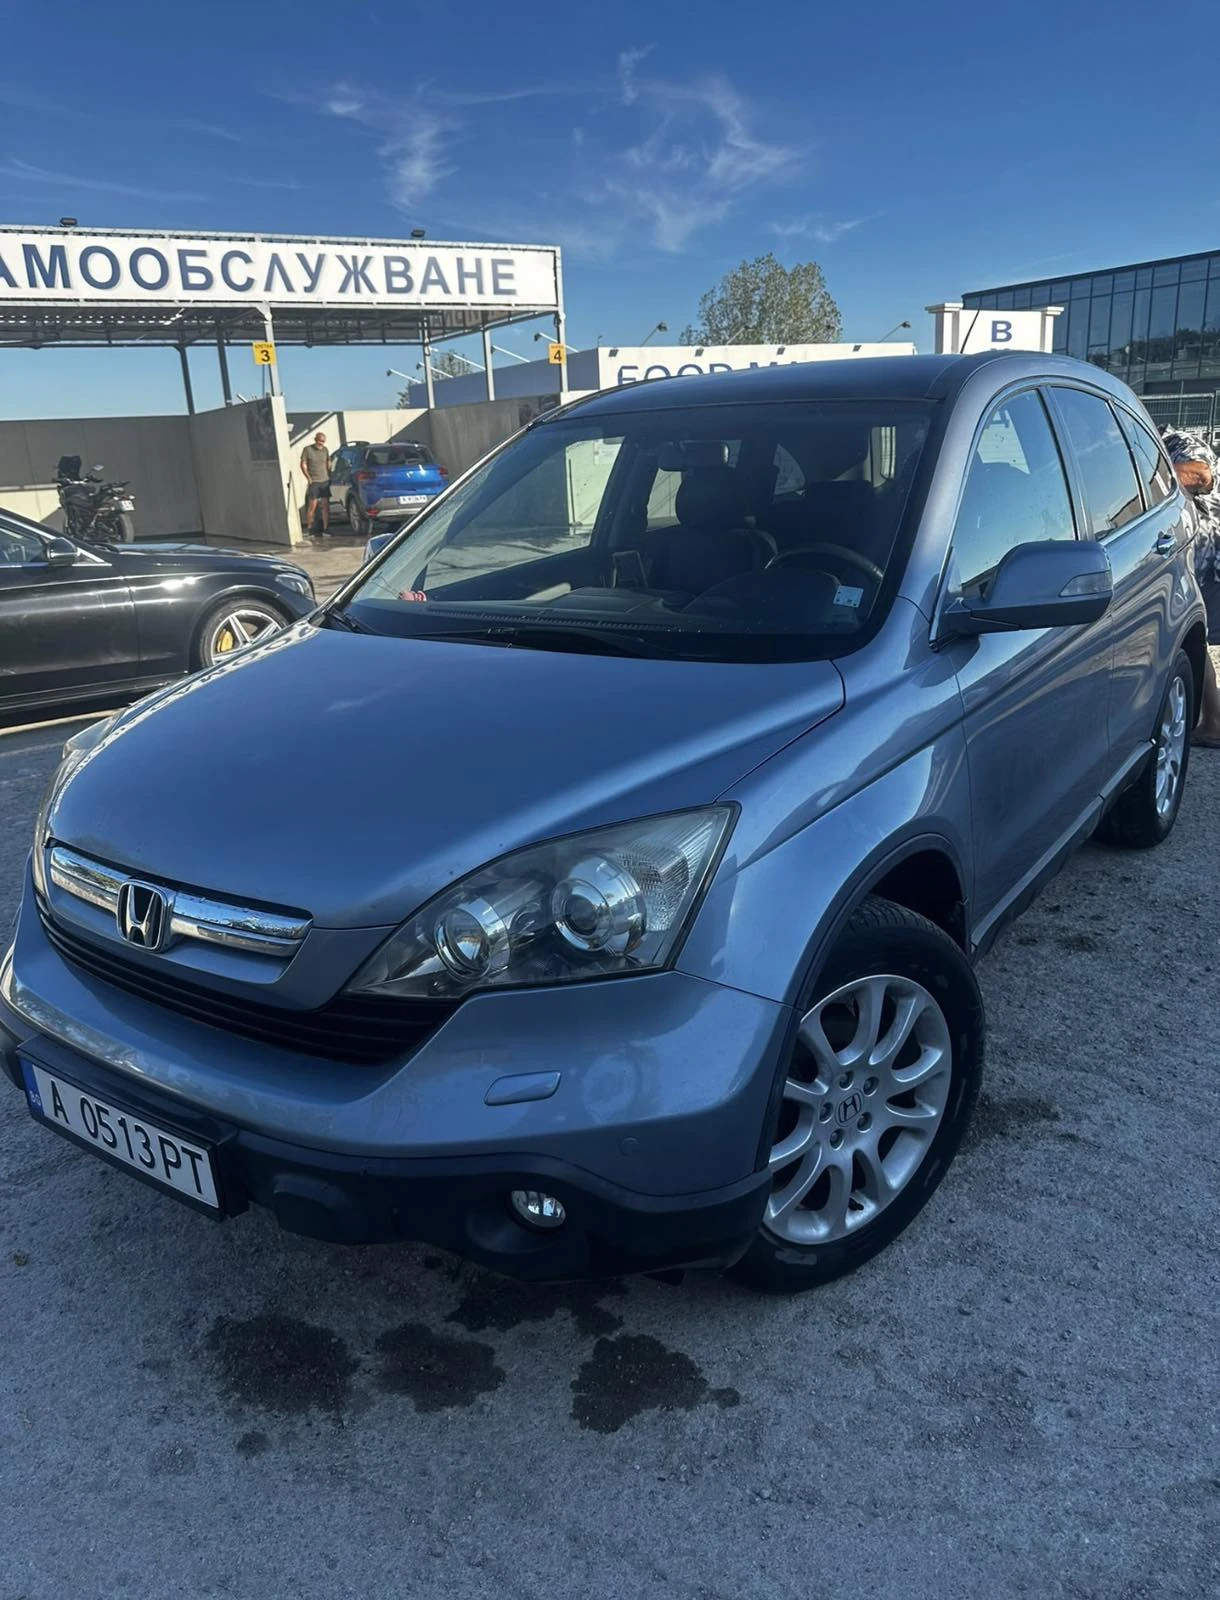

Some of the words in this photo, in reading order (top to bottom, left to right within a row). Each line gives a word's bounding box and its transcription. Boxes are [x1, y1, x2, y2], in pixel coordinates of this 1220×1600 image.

[260, 349, 271, 363] 3
[553, 350, 563, 362] 4
[51, 1080, 70, 1125] A
